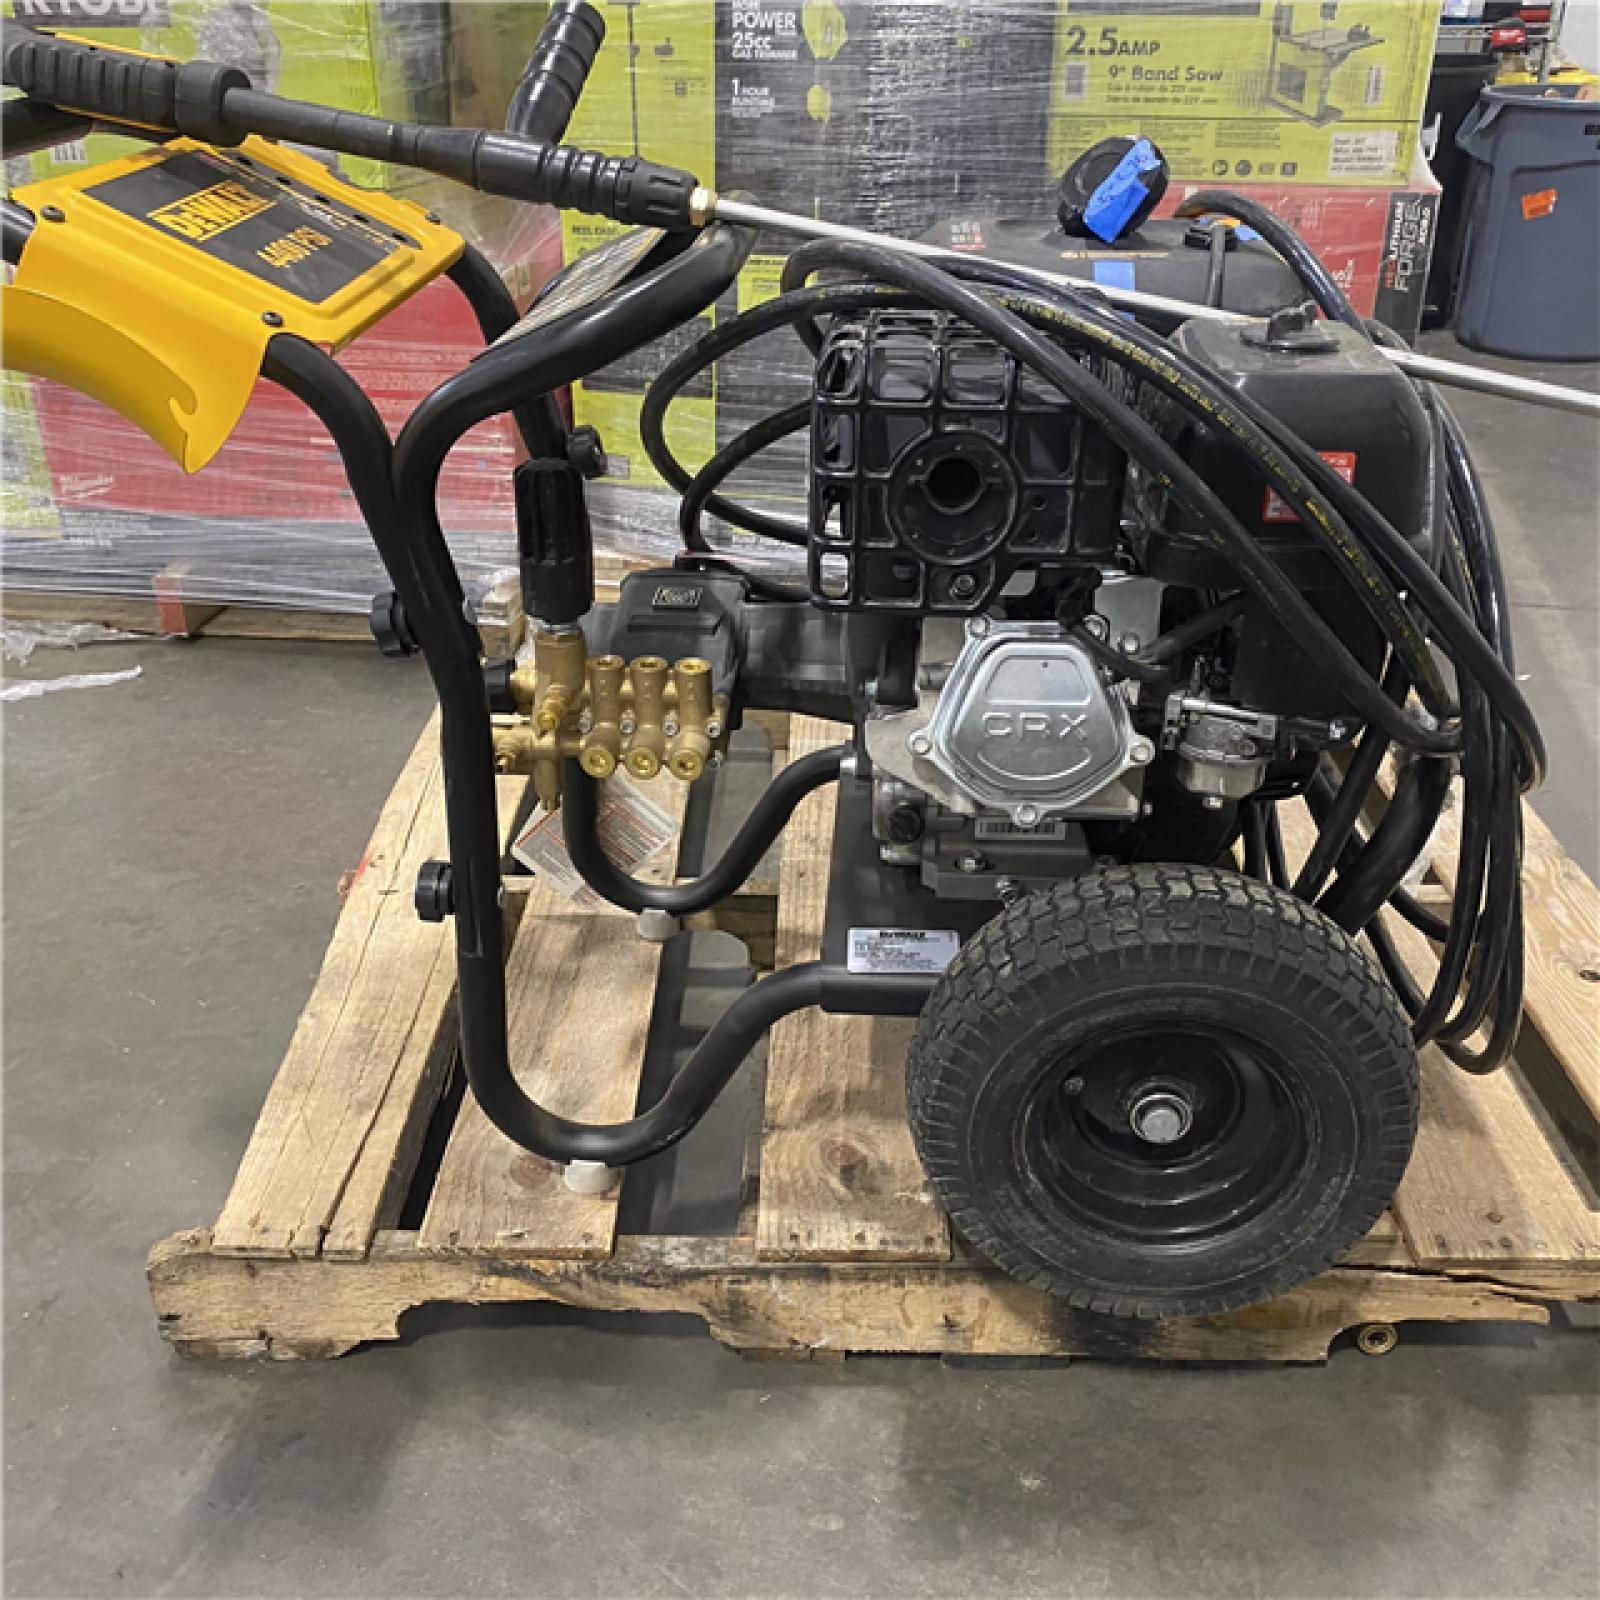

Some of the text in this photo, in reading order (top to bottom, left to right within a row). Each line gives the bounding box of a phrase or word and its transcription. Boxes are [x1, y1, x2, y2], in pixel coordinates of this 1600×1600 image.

[732, 11, 797, 29] POWER
[731, 32, 771, 49] 25cc
[1132, 65, 1180, 81] Band
[1185, 65, 1223, 82] Saw
[1394, 204, 1420, 293] FORGE
[982, 711, 1088, 740] CRX
